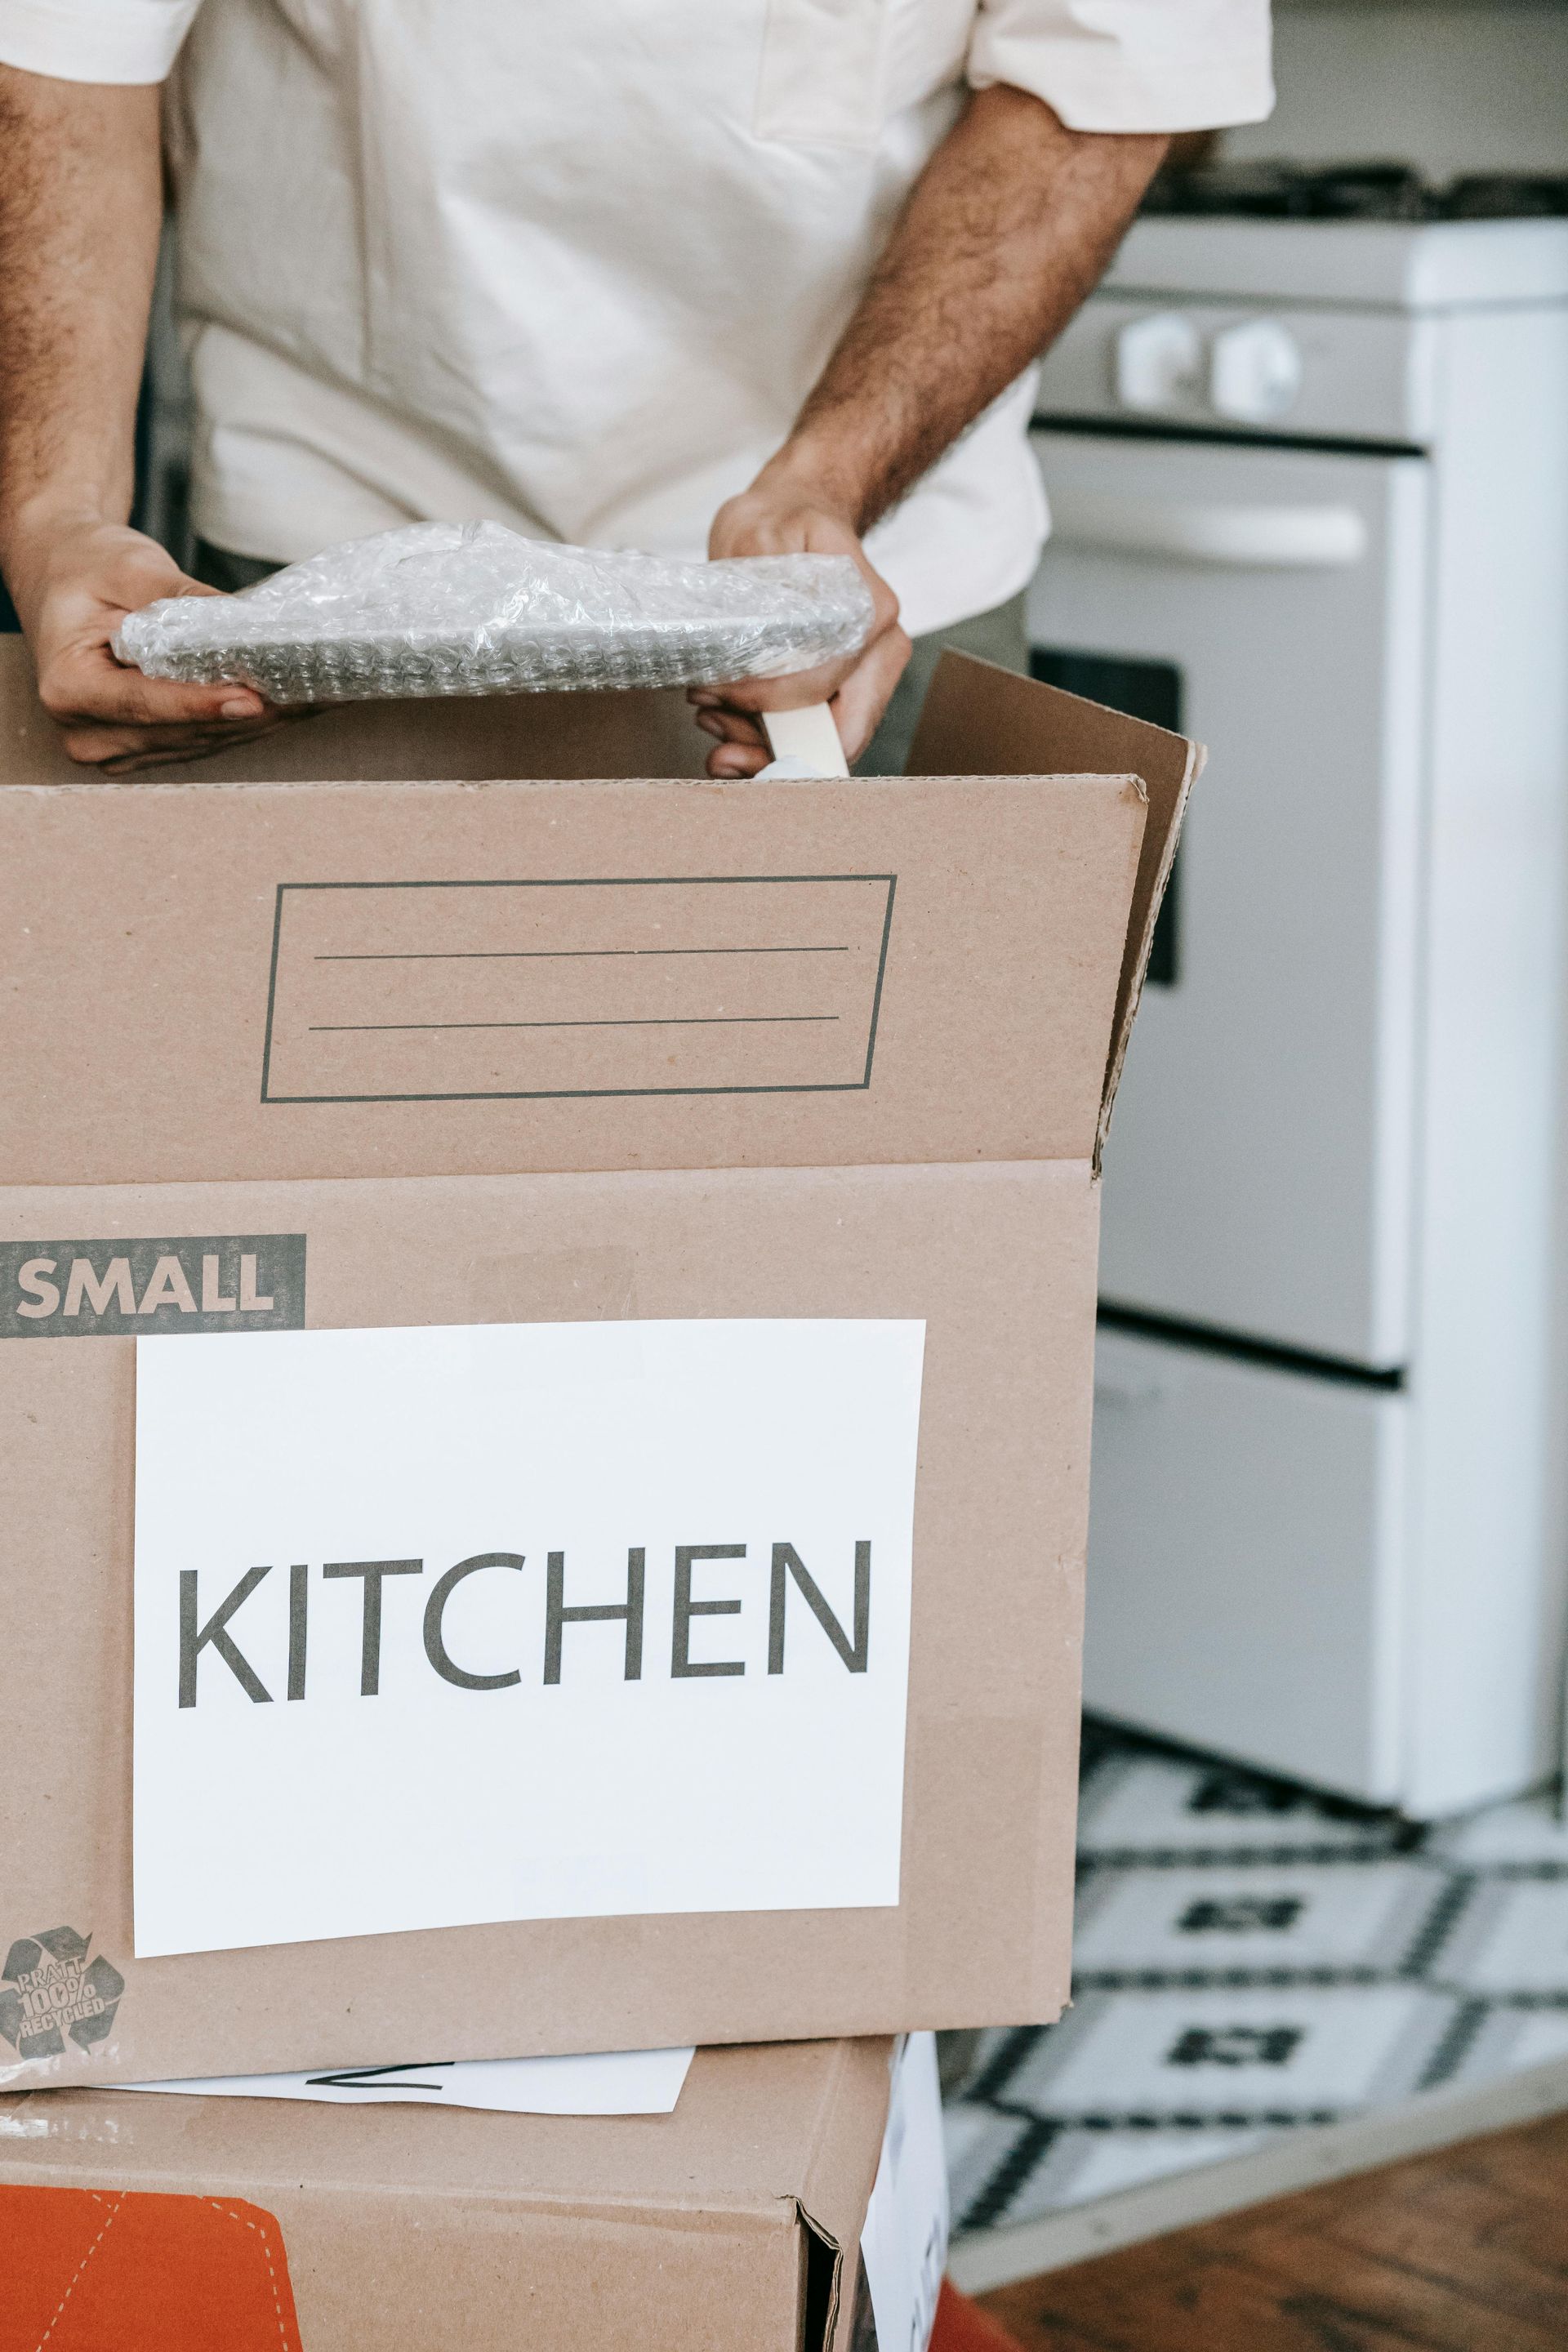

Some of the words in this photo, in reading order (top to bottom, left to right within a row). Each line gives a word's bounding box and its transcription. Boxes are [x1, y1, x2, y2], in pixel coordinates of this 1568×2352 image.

[16, 1254, 274, 1319] SMALL
[178, 1539, 871, 1708] KITCHEN
[17, 1957, 84, 1993] PRATT
[19, 1976, 96, 2019] 100%
[20, 1998, 106, 2038] RECYCLED
